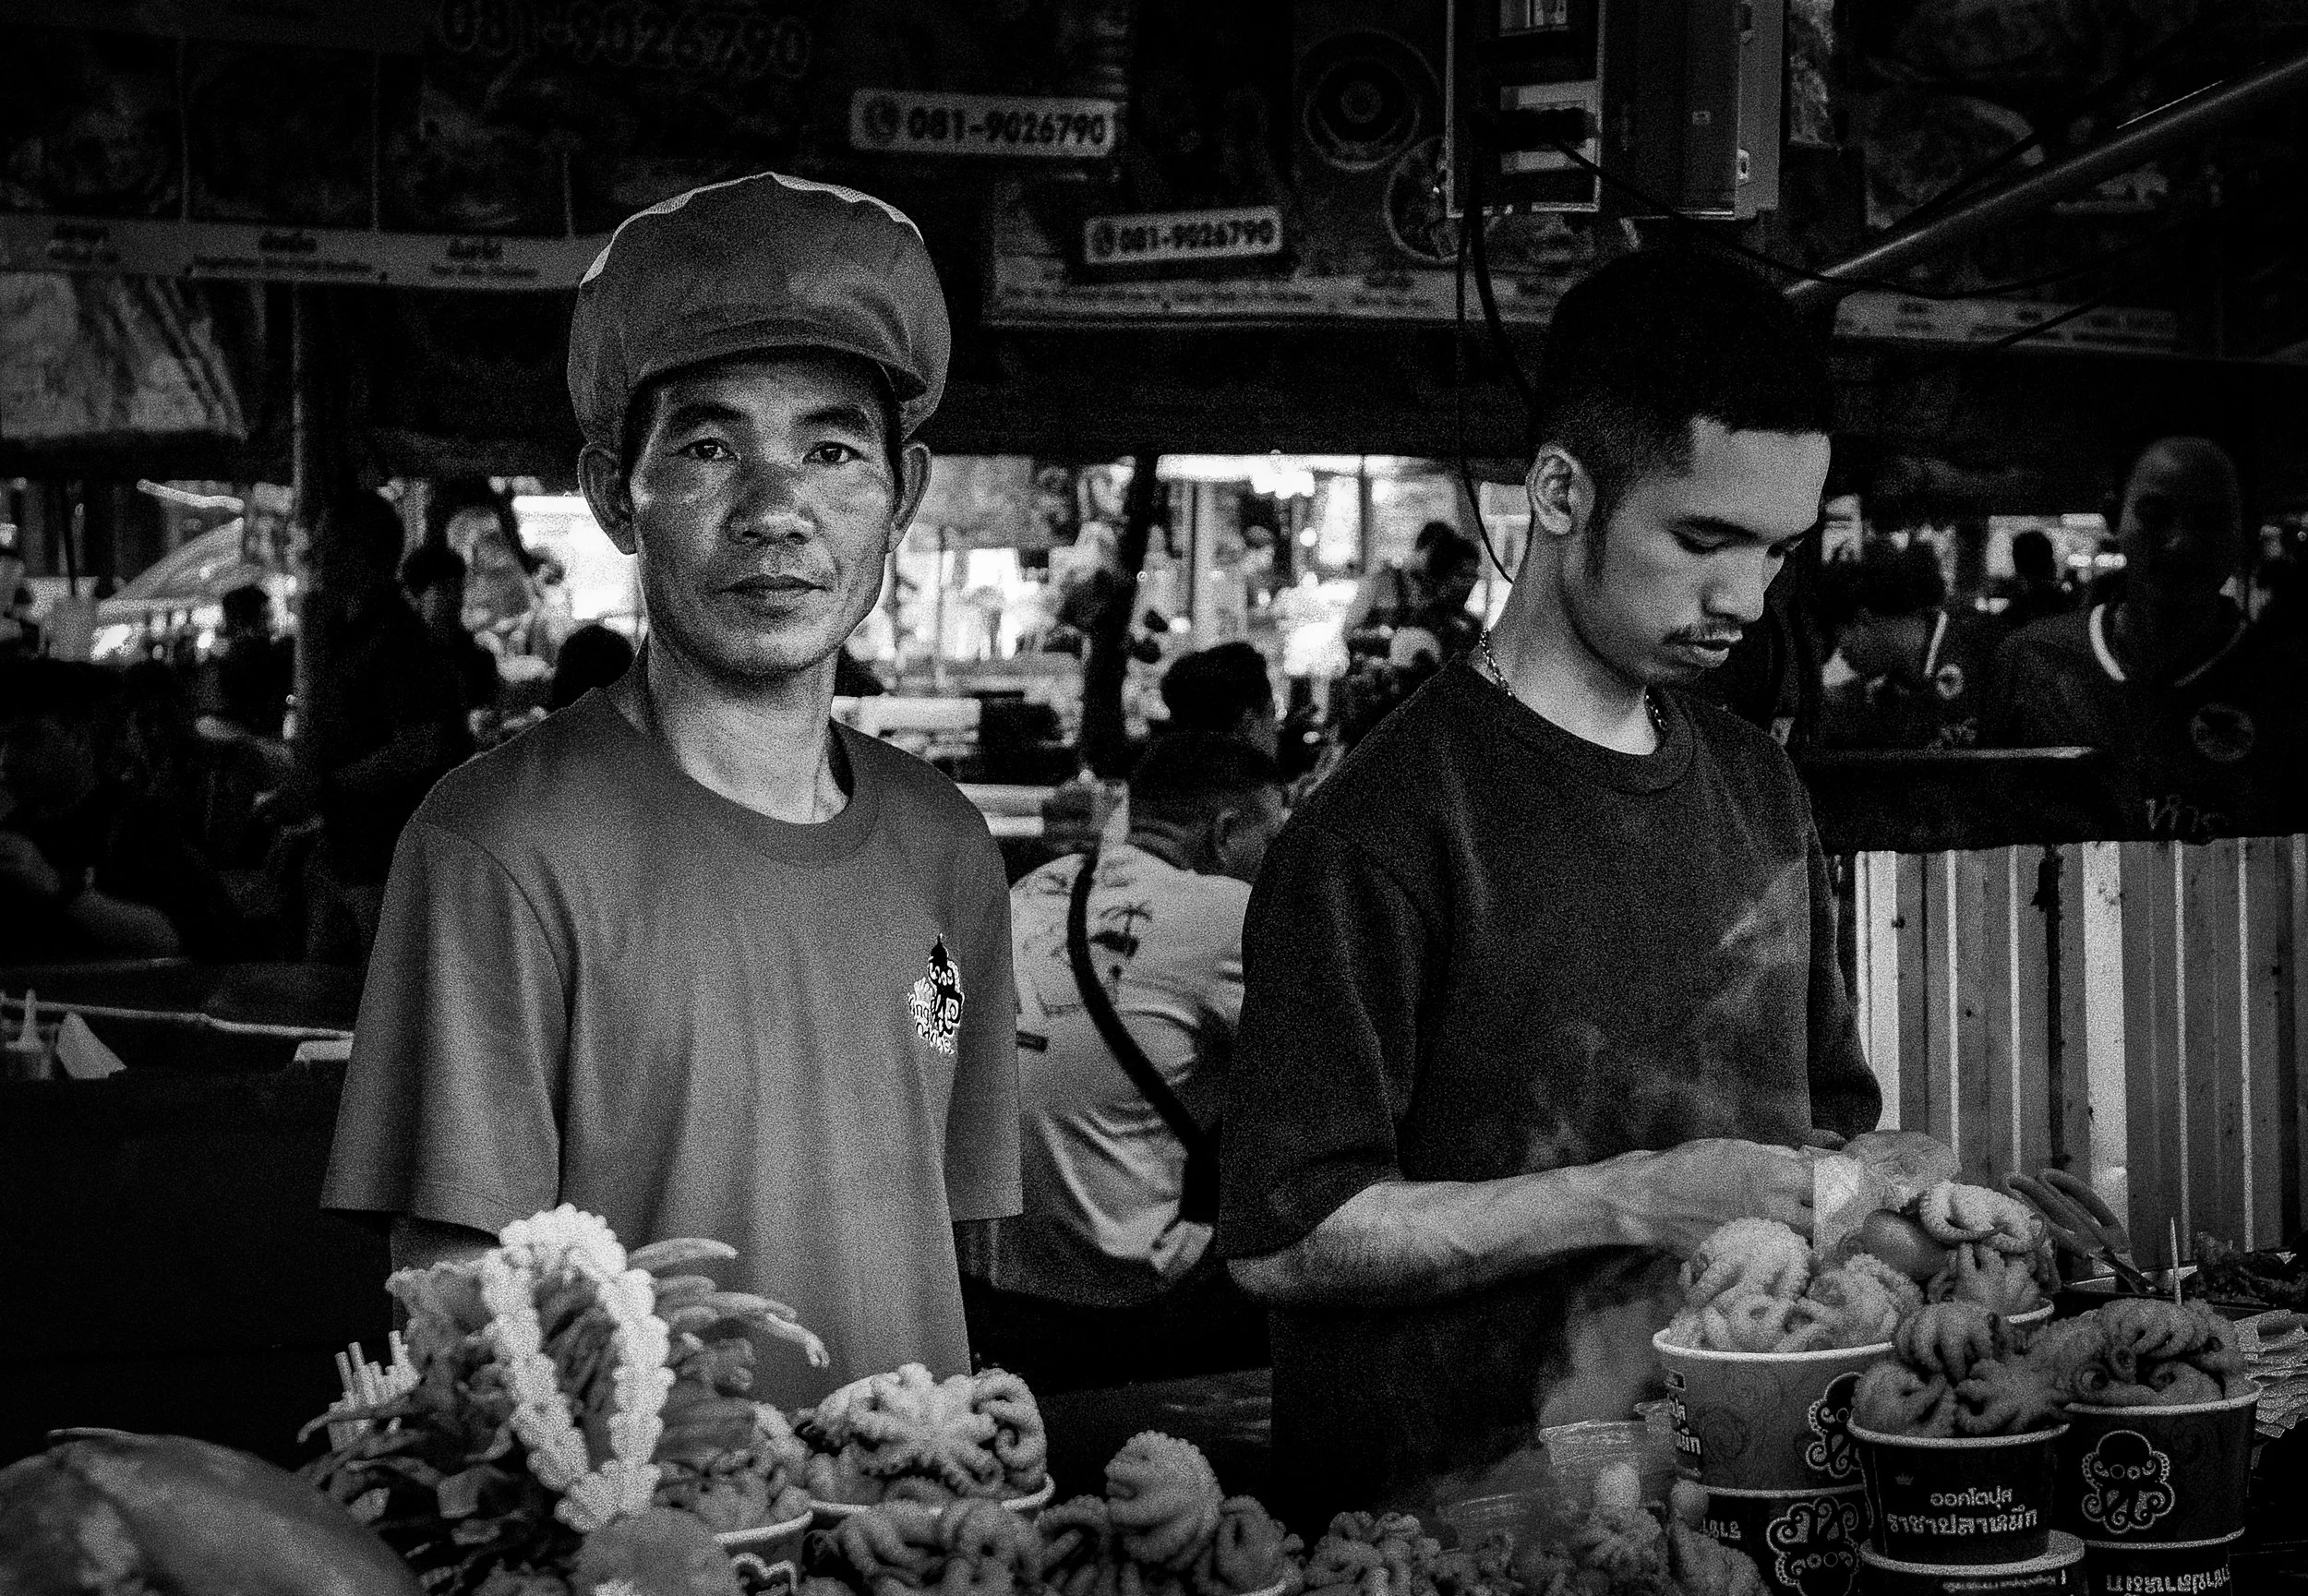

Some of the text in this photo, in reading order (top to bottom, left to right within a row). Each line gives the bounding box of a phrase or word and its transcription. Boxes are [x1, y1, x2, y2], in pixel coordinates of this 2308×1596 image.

[438, 0, 812, 81] 081-9026790
[908, 106, 1105, 146] 081-9026790
[1119, 218, 1274, 254] 081-9026790
[1885, 1503, 2039, 1537] ราชาปลาหมึก
